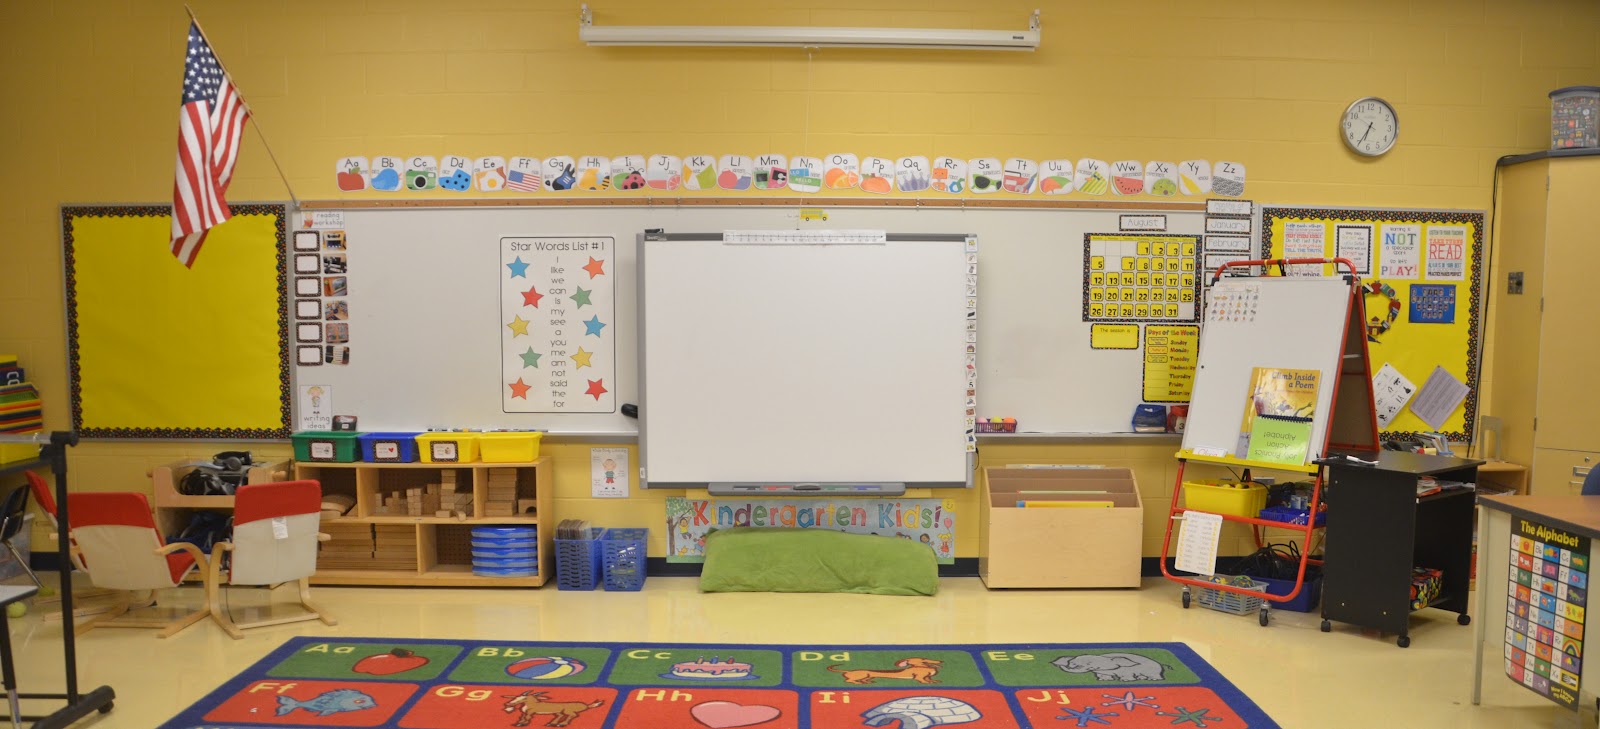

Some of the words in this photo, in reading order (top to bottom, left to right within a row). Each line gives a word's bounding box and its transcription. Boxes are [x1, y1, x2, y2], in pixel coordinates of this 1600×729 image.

[1358, 105, 1365, 113] 11
[1367, 103, 1375, 111] 12
[1350, 112, 1358, 120] 10
[344, 158, 359, 168] Aa
[381, 158, 394, 167] Bb
[413, 158, 427, 167] Cc
[450, 157, 464, 168] Dd
[483, 158, 496, 168] Ee
[518, 158, 531, 168] Ff
[549, 158, 564, 171] Gg
[587, 157, 600, 167] Hh
[625, 156, 632, 167] Ii
[658, 156, 670, 171] Jj
[692, 156, 706, 167] Kk
[730, 156, 741, 167] Ll
[760, 156, 779, 166] Mm
[800, 158, 813, 169] Nn
[832, 155, 848, 165] Oo
[902, 158, 922, 172] Qq
[944, 158, 958, 170] Rr
[978, 159, 990, 170] Ss
[1048, 160, 1062, 171] Uu
[1088, 160, 1099, 171] Vv
[872, 158, 885, 174] Pp
[1116, 161, 1136, 172] Ww
[1155, 162, 1169, 173] Xx
[1187, 161, 1200, 175] Yy
[1223, 162, 1236, 174] Zz
[314, 220, 344, 228] workshop
[1127, 217, 1159, 228] August
[1211, 221, 1246, 230] January
[1208, 238, 1247, 249] February
[1385, 233, 1416, 245] NOT
[511, 241, 532, 251] Star
[534, 241, 570, 251] Words
[572, 241, 589, 251] List
[1158, 247, 1164, 255] 2
[1429, 244, 1462, 260] READ
[550, 266, 565, 274] like
[1381, 264, 1417, 276] PLAY!
[550, 308, 566, 316] my
[1092, 308, 1102, 316] 26
[550, 339, 567, 347] you
[550, 359, 566, 367] am
[551, 369, 566, 377] not
[1272, 372, 1293, 380] Climb
[1294, 372, 1316, 381] Inside
[549, 379, 568, 387] said
[1294, 381, 1314, 389] Poem
[552, 389, 566, 397] the
[553, 400, 565, 408] for
[303, 414, 330, 424] writing
[1178, 422, 1185, 430] 3
[1266, 441, 1290, 449] Action
[1254, 449, 1281, 459] Phonics
[692, 500, 867, 528] Kindergarten
[877, 501, 942, 529] Kids!
[1520, 520, 1535, 535] The
[1536, 525, 1579, 547] Alphabet
[304, 643, 356, 654] Aa
[476, 648, 525, 658] Bb
[627, 649, 672, 660] Cc
[799, 651, 850, 662] Dd
[987, 650, 1034, 661] Ee
[248, 682, 298, 695] Ff
[435, 686, 493, 701] Gg
[635, 689, 693, 702] Hh
[818, 691, 850, 704] Ii
[1027, 690, 1071, 705] Jj
